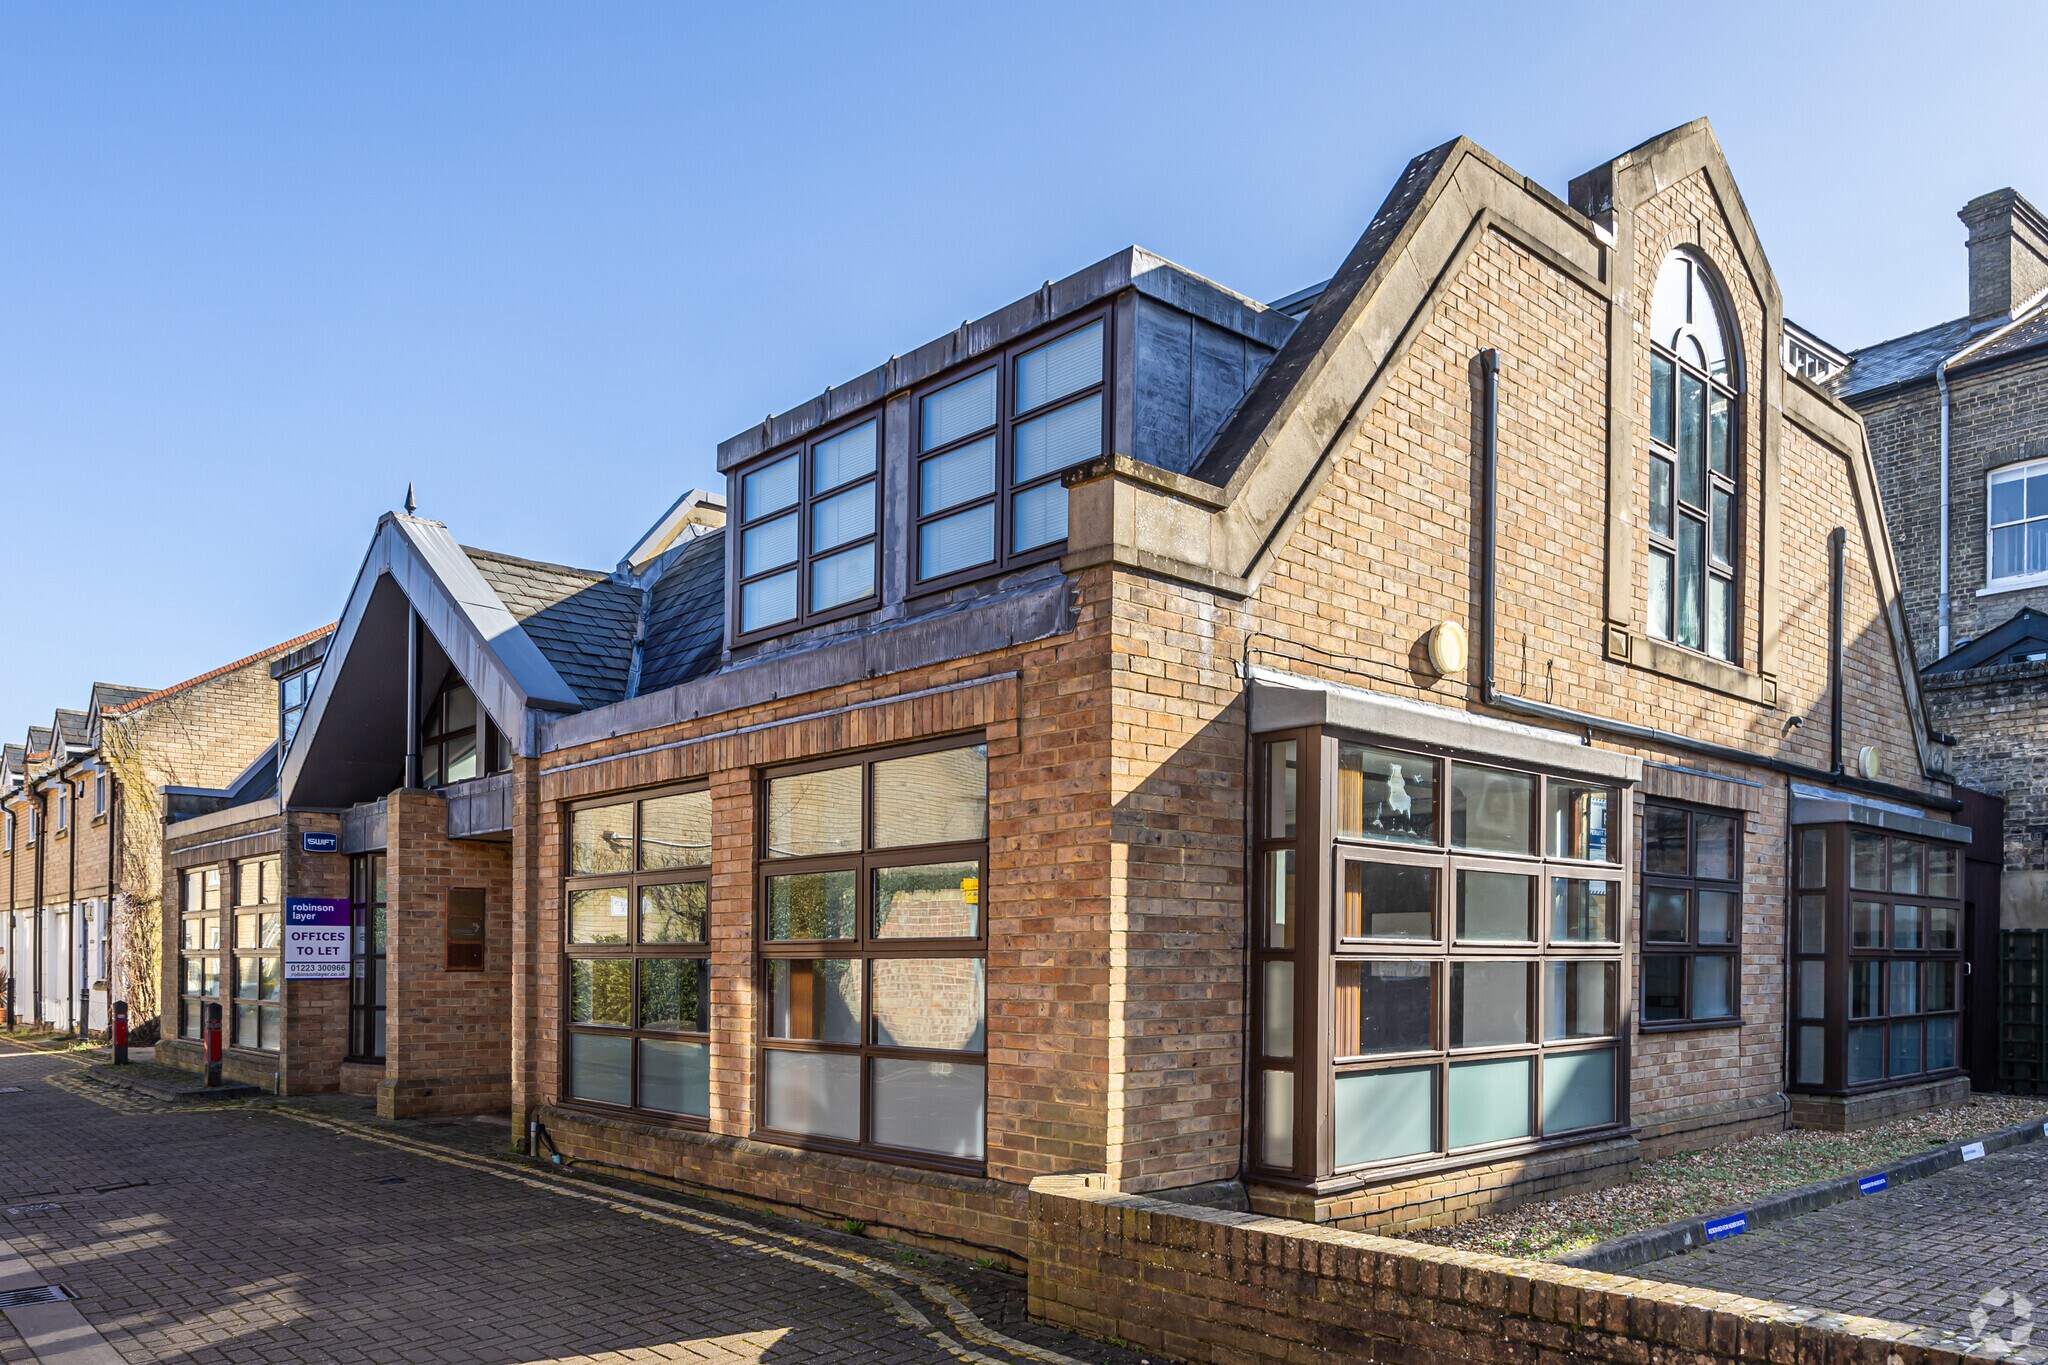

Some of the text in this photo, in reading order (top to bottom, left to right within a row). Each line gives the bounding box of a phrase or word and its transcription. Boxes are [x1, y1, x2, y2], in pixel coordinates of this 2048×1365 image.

[308, 838, 335, 846] SWIFT
[292, 903, 334, 912] robinson
[292, 912, 316, 921] layer
[291, 932, 345, 941] OFFICES
[296, 946, 340, 955] TO LET
[290, 964, 346, 972] 01223 300966
